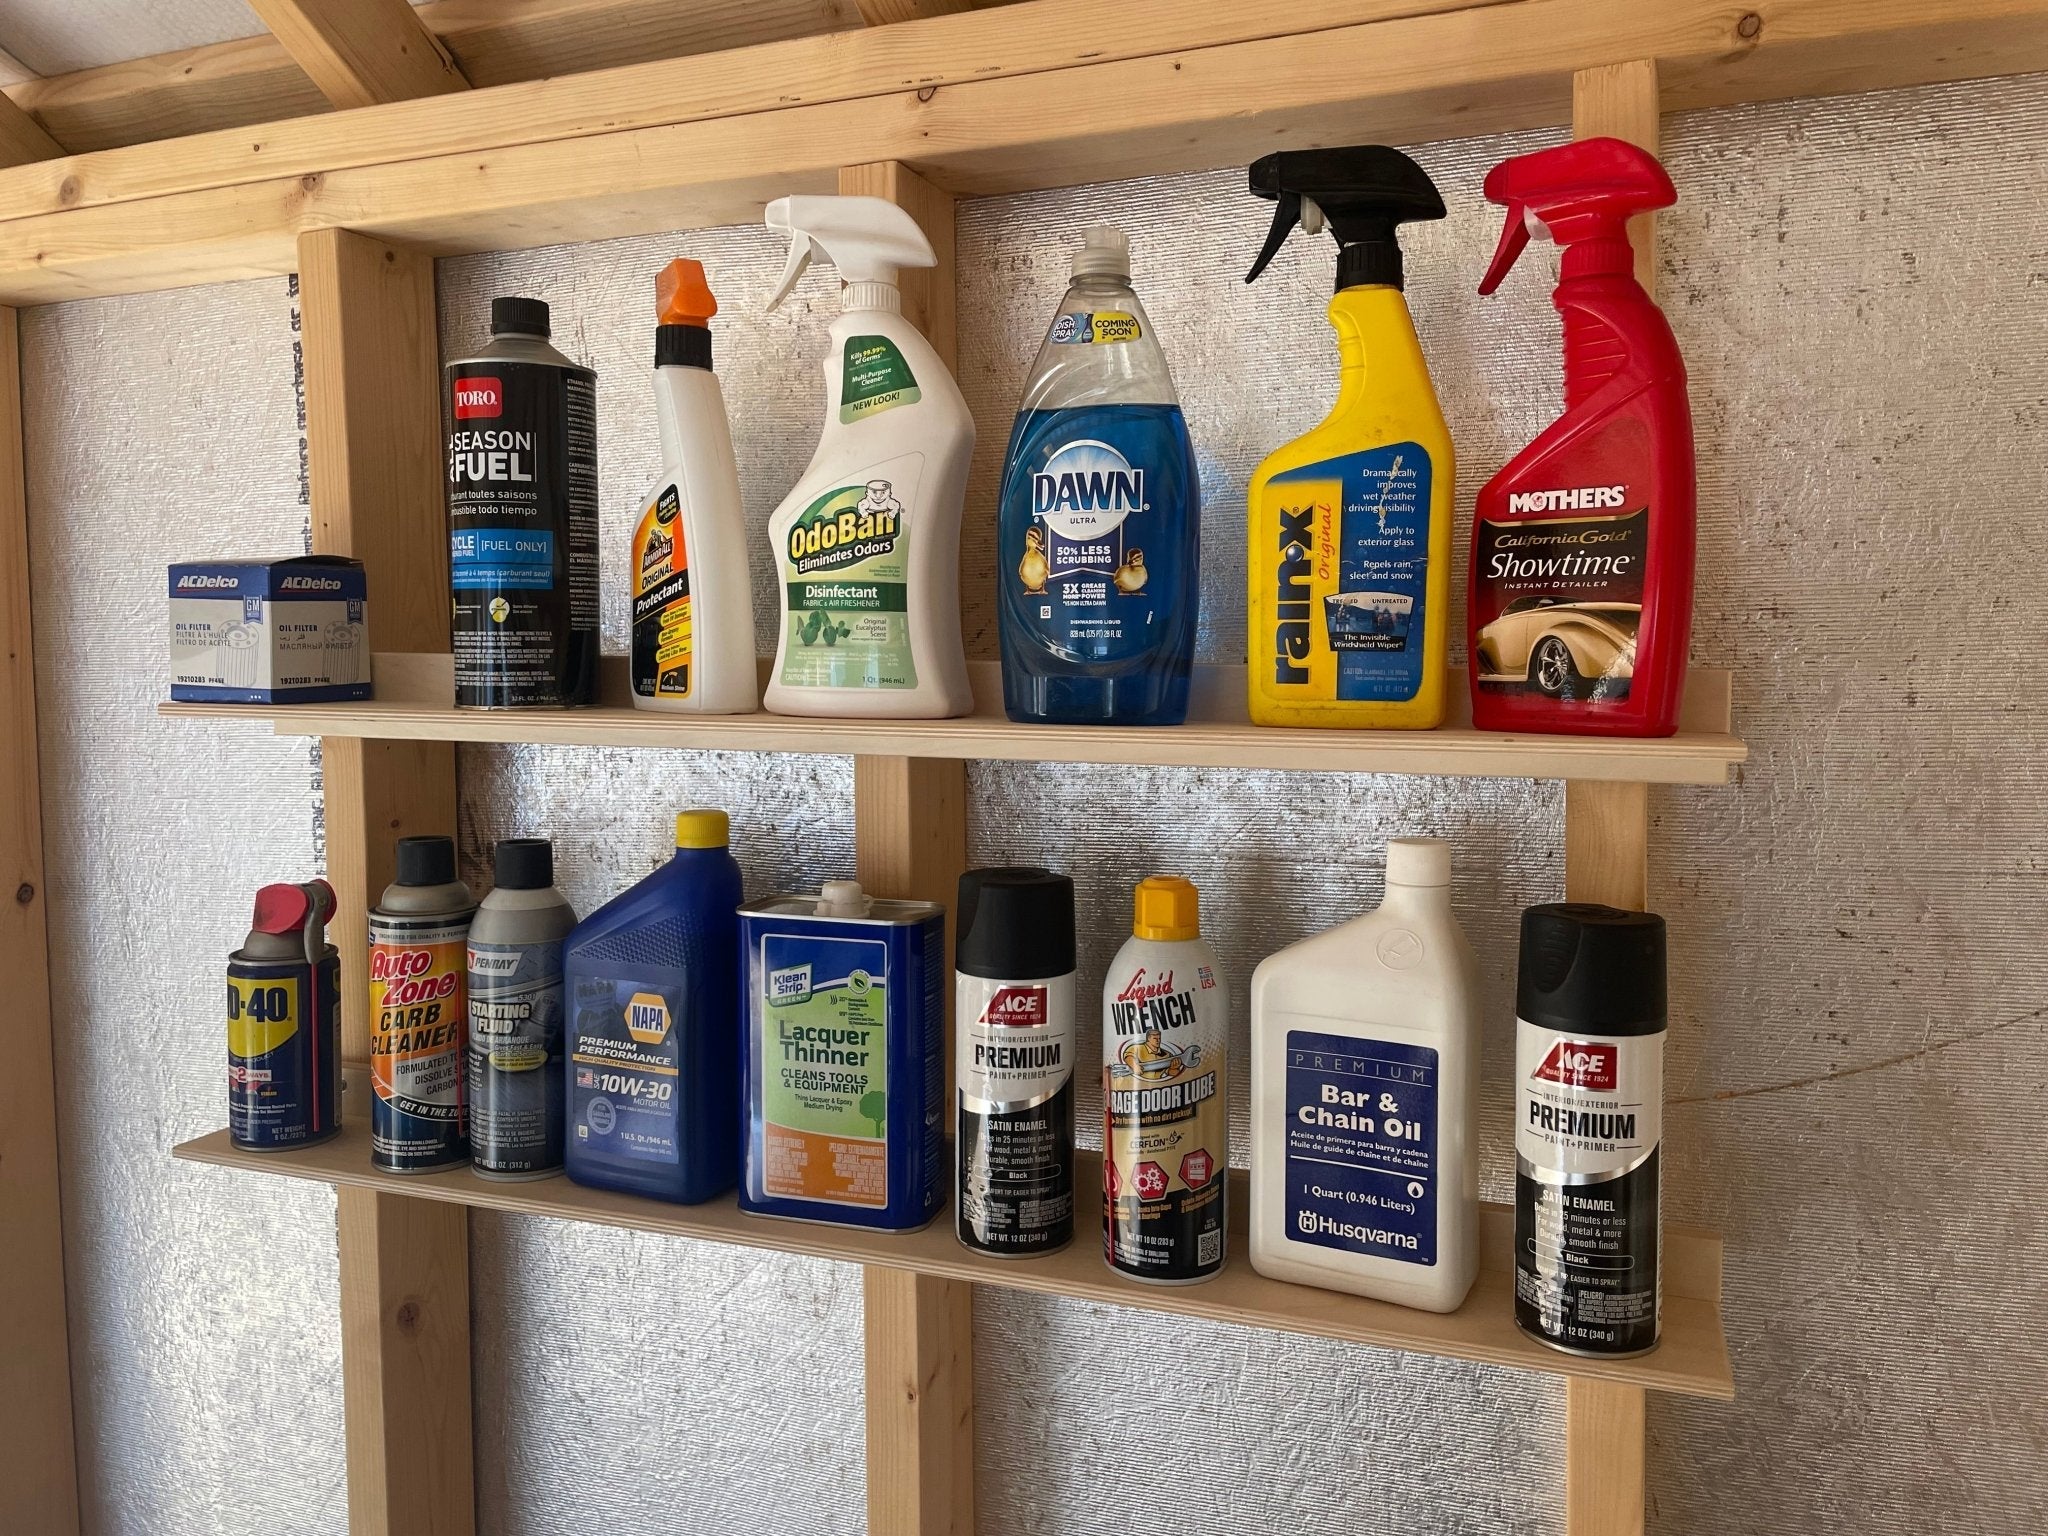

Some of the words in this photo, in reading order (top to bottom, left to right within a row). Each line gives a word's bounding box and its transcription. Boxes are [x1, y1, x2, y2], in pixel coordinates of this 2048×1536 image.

[1057, 321, 1075, 329] DISH
[1095, 319, 1135, 328] COMING
[1052, 329, 1077, 338] SPRAY
[1102, 328, 1132, 336] SOON
[852, 368, 892, 383] Multi-Purpose
[861, 375, 883, 386] Cleaner
[457, 390, 496, 406] TORO
[853, 399, 872, 411] NEW
[874, 392, 900, 405] LOOK!
[456, 452, 532, 482] FUEL
[1363, 468, 1417, 478] Dramacally
[469, 490, 495, 498] toutes
[498, 490, 537, 500] saisons
[1033, 469, 1144, 516] DAWN
[1382, 492, 1416, 501] weather
[1509, 485, 1625, 514] MOTHERS
[479, 505, 498, 514] todo
[502, 506, 537, 516] tiempo
[1348, 504, 1378, 513] driving
[1070, 517, 1096, 525] ULTRA
[791, 511, 894, 558] OdoBan
[1379, 527, 1403, 536] Apply
[1318, 503, 1335, 581] Original
[1358, 538, 1391, 546] exterior
[1394, 537, 1414, 547] glass
[799, 550, 852, 572] Eliminates
[854, 541, 890, 557] Odors
[1057, 547, 1078, 556] 50%
[1082, 546, 1110, 555] LESS
[1057, 556, 1111, 564] SCRUBBING
[1363, 560, 1391, 570] Repels
[1487, 550, 1630, 579] Showtime
[177, 575, 238, 588] ACDelco
[281, 576, 341, 590] ACDelco
[642, 562, 673, 589] ORIGINAL
[636, 578, 683, 614] Protectant
[806, 585, 877, 598] Disinfectant
[1063, 584, 1079, 594] 3X
[246, 599, 259, 612] GM
[371, 950, 432, 980] Auto
[476, 958, 514, 969] PENRAY
[774, 972, 807, 985] Klean
[1201, 979, 1216, 989] USA
[381, 972, 456, 1007] Zone
[1118, 968, 1173, 1008] Liquid
[228, 984, 288, 1022] D-40
[471, 1001, 530, 1019] STARTING
[995, 994, 1038, 1012] ACE
[381, 1003, 442, 1032] CARB
[632, 1005, 663, 1031] NAPA
[1112, 991, 1196, 1035] WRENCH
[478, 1019, 514, 1034] FLUID
[780, 1020, 870, 1049] Lacquer
[579, 1036, 637, 1051] PREMIUM
[579, 1045, 671, 1066] PERFORMANCE
[780, 1040, 869, 1066] Thinner
[975, 1043, 1060, 1068] PREMIUM
[1556, 1050, 1605, 1072] ACE
[396, 1057, 447, 1075] FORMULATED
[619, 1062, 656, 1072] PROTECTION
[1296, 1054, 1424, 1082] PREMIUM
[415, 1068, 452, 1085] DISSOLVE
[781, 1068, 826, 1082] CLEANS
[829, 1073, 868, 1085] TOOLS
[989, 1071, 1046, 1080] PAINT+PRIMER
[601, 1074, 672, 1100] 10W-30
[784, 1078, 791, 1088] &
[794, 1080, 866, 1094] EQUIPMENT
[1111, 1091, 1139, 1114] RAGE
[1142, 1085, 1181, 1113] DOOR
[1185, 1073, 1214, 1105] LUBE
[633, 1098, 658, 1108] MOTOR
[810, 1095, 830, 1104] Lacquer
[836, 1098, 852, 1107] Epoxy
[1321, 1084, 1370, 1108] Bar
[1379, 1093, 1399, 1113] &
[400, 1100, 417, 1111] GET
[418, 1105, 427, 1115] IN
[430, 1107, 447, 1117] THE
[804, 1101, 824, 1110] Medium
[826, 1104, 843, 1113] Drying
[988, 1120, 1012, 1132] SATIN
[1015, 1120, 1047, 1132] ENAMEL
[1298, 1106, 1375, 1133] Chain
[1384, 1118, 1421, 1142] Oil
[1530, 1100, 1635, 1139] PREMIUM
[285, 1124, 305, 1133] WEIGHT
[1291, 1130, 1314, 1140] Aceite
[1327, 1136, 1356, 1146] primera
[1357, 1141, 1373, 1149] para
[1376, 1142, 1395, 1152] barra
[1402, 1148, 1428, 1159] cadena
[1291, 1140, 1310, 1149] Huile
[1312, 1142, 1321, 1150] de
[1324, 1144, 1344, 1154] guide
[1346, 1147, 1355, 1155] de
[1357, 1150, 1380, 1160] chaîne
[1383, 1154, 1391, 1162] et
[1393, 1155, 1401, 1163] de
[1403, 1158, 1428, 1168] chaîne
[1312, 1185, 1343, 1200] Quart
[1346, 1191, 1377, 1206] (0.946
[1381, 1197, 1415, 1215] Liters)
[1543, 1190, 1570, 1207] SATIN
[1573, 1197, 1615, 1212] ENAMEL
[1571, 1213, 1601, 1225] minutes
[1613, 1217, 1626, 1226] less
[1320, 1216, 1418, 1250] Husqvarna
[1572, 1226, 1593, 1236] metal
[1603, 1230, 1622, 1238] more
[1569, 1238, 1597, 1248] smooth
[1599, 1242, 1619, 1250] finish
[1566, 1253, 1589, 1265] Black
[1571, 1273, 1590, 1284] EASIER
[1568, 1326, 1576, 1335] 12
[1578, 1328, 1587, 1337] OZ
[1589, 1329, 1605, 1340] (340
